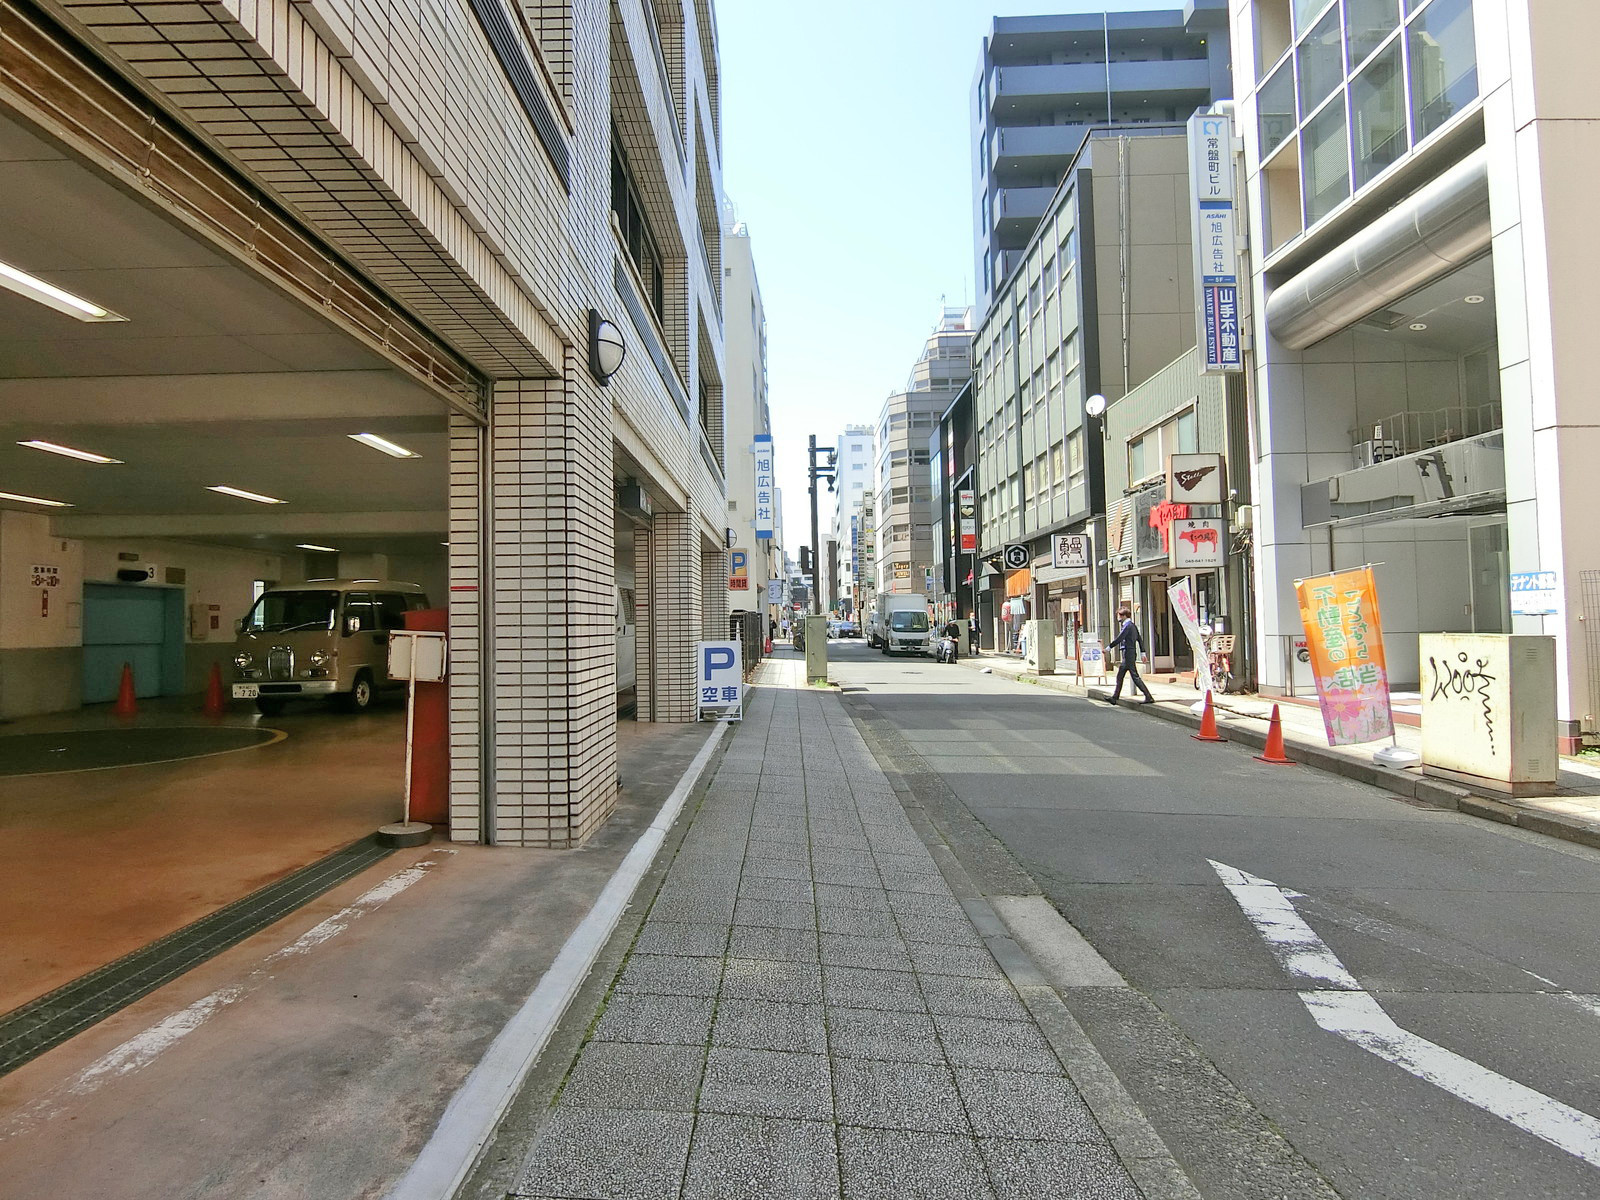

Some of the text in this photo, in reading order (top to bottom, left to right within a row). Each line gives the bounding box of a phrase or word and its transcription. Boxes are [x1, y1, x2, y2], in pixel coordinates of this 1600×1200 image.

[1207, 138, 1221, 195] 常盤町ビル
[1211, 222, 1225, 273] 旭広告社
[1206, 289, 1216, 362] YAMATE REAL ESTATE
[1220, 289, 1237, 362] 山手不動産
[757, 459, 770, 520] 旭広告社
[1188, 521, 1209, 529] 焼肉
[149, 567, 154, 578] 3
[731, 552, 747, 576] P
[730, 578, 747, 588] 時間貸
[704, 647, 735, 681] P
[702, 686, 738, 702] 空車
